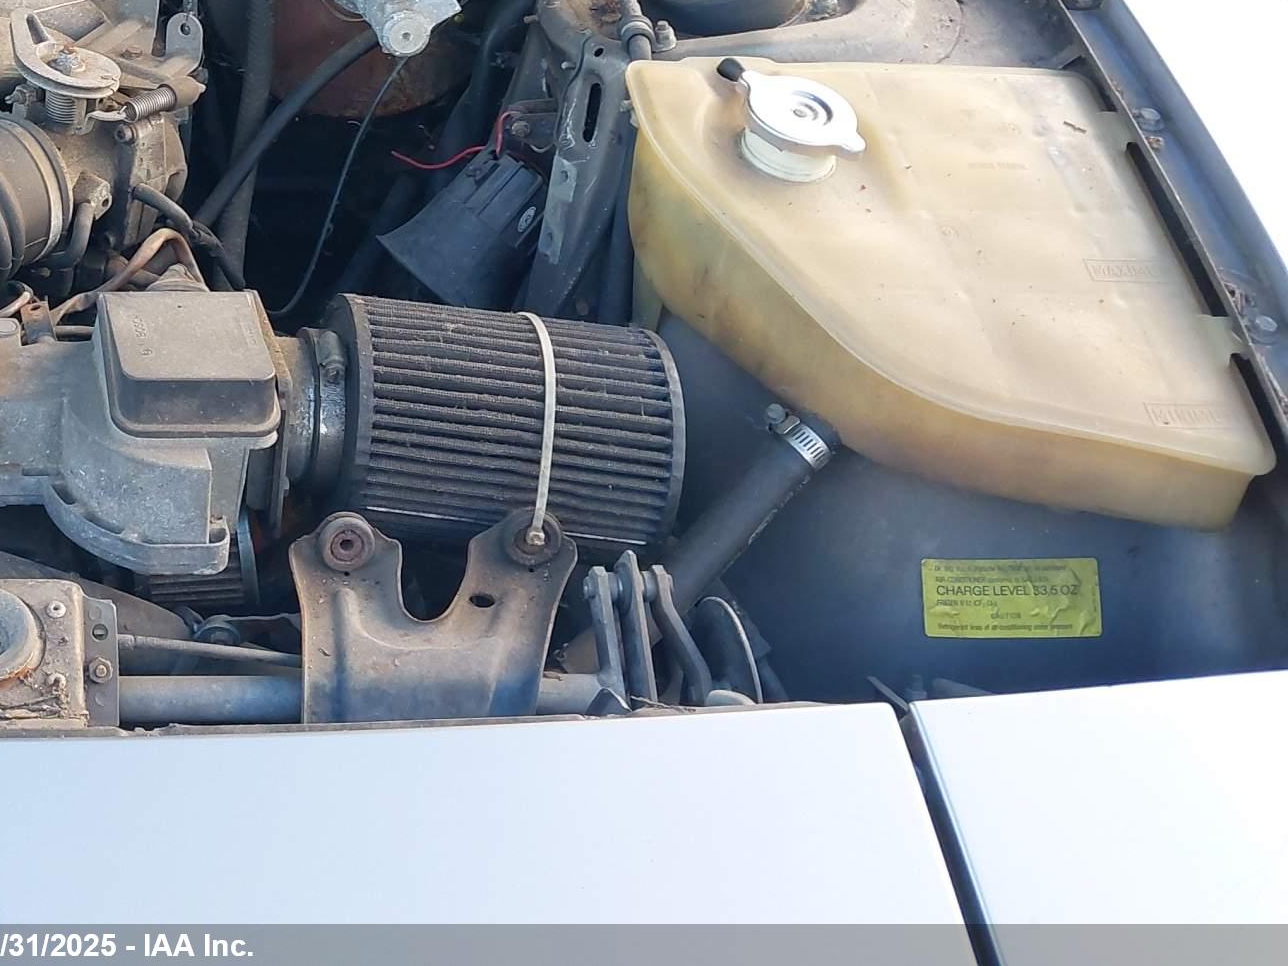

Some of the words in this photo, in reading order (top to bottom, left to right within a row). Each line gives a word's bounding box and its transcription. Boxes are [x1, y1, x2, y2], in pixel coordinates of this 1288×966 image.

[936, 585, 990, 596] CHARGE
[992, 585, 1031, 596] LEVEL
[1061, 585, 1079, 596] OZ
